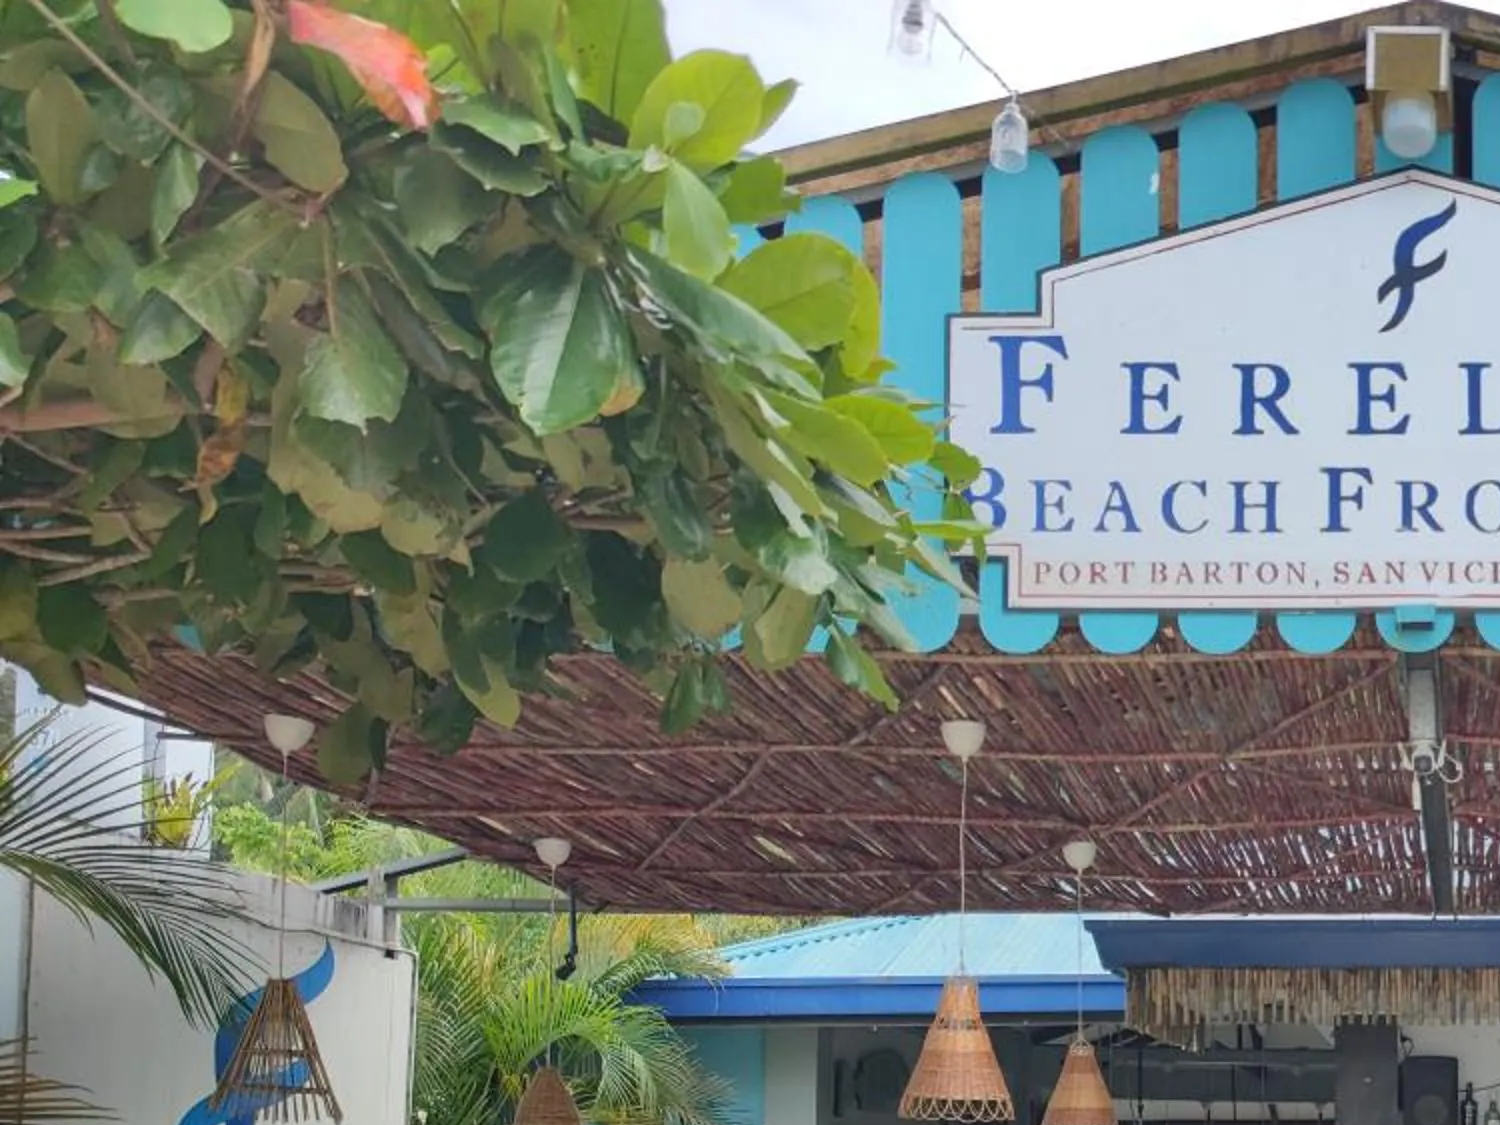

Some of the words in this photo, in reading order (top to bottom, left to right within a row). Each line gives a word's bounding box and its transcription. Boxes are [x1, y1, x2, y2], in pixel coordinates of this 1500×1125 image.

[1033, 561, 1136, 585] PORT
[1149, 560, 1321, 588] BARTON,
[1333, 560, 1406, 585] SAN
